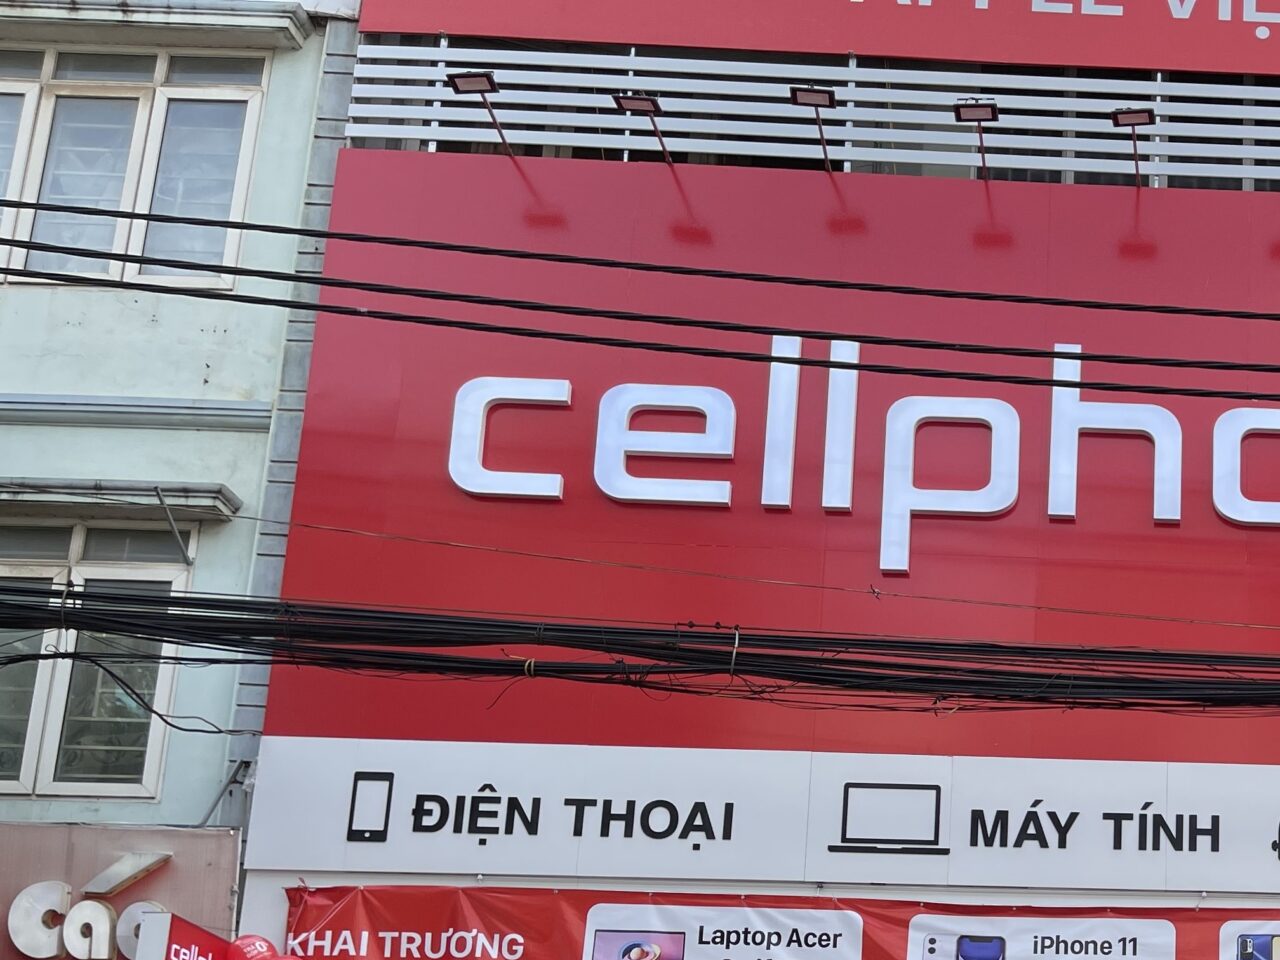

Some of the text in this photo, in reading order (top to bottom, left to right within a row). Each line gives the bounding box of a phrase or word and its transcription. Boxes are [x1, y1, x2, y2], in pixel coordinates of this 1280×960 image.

[412, 784, 735, 851] ĐIỆN THOẠI
[970, 799, 1220, 852] MÁY TÍNH
[288, 928, 524, 959] KHAI TRƯƠNG
[698, 926, 842, 950] Laptop Acer
[1033, 936, 1138, 956] iPhone 11
